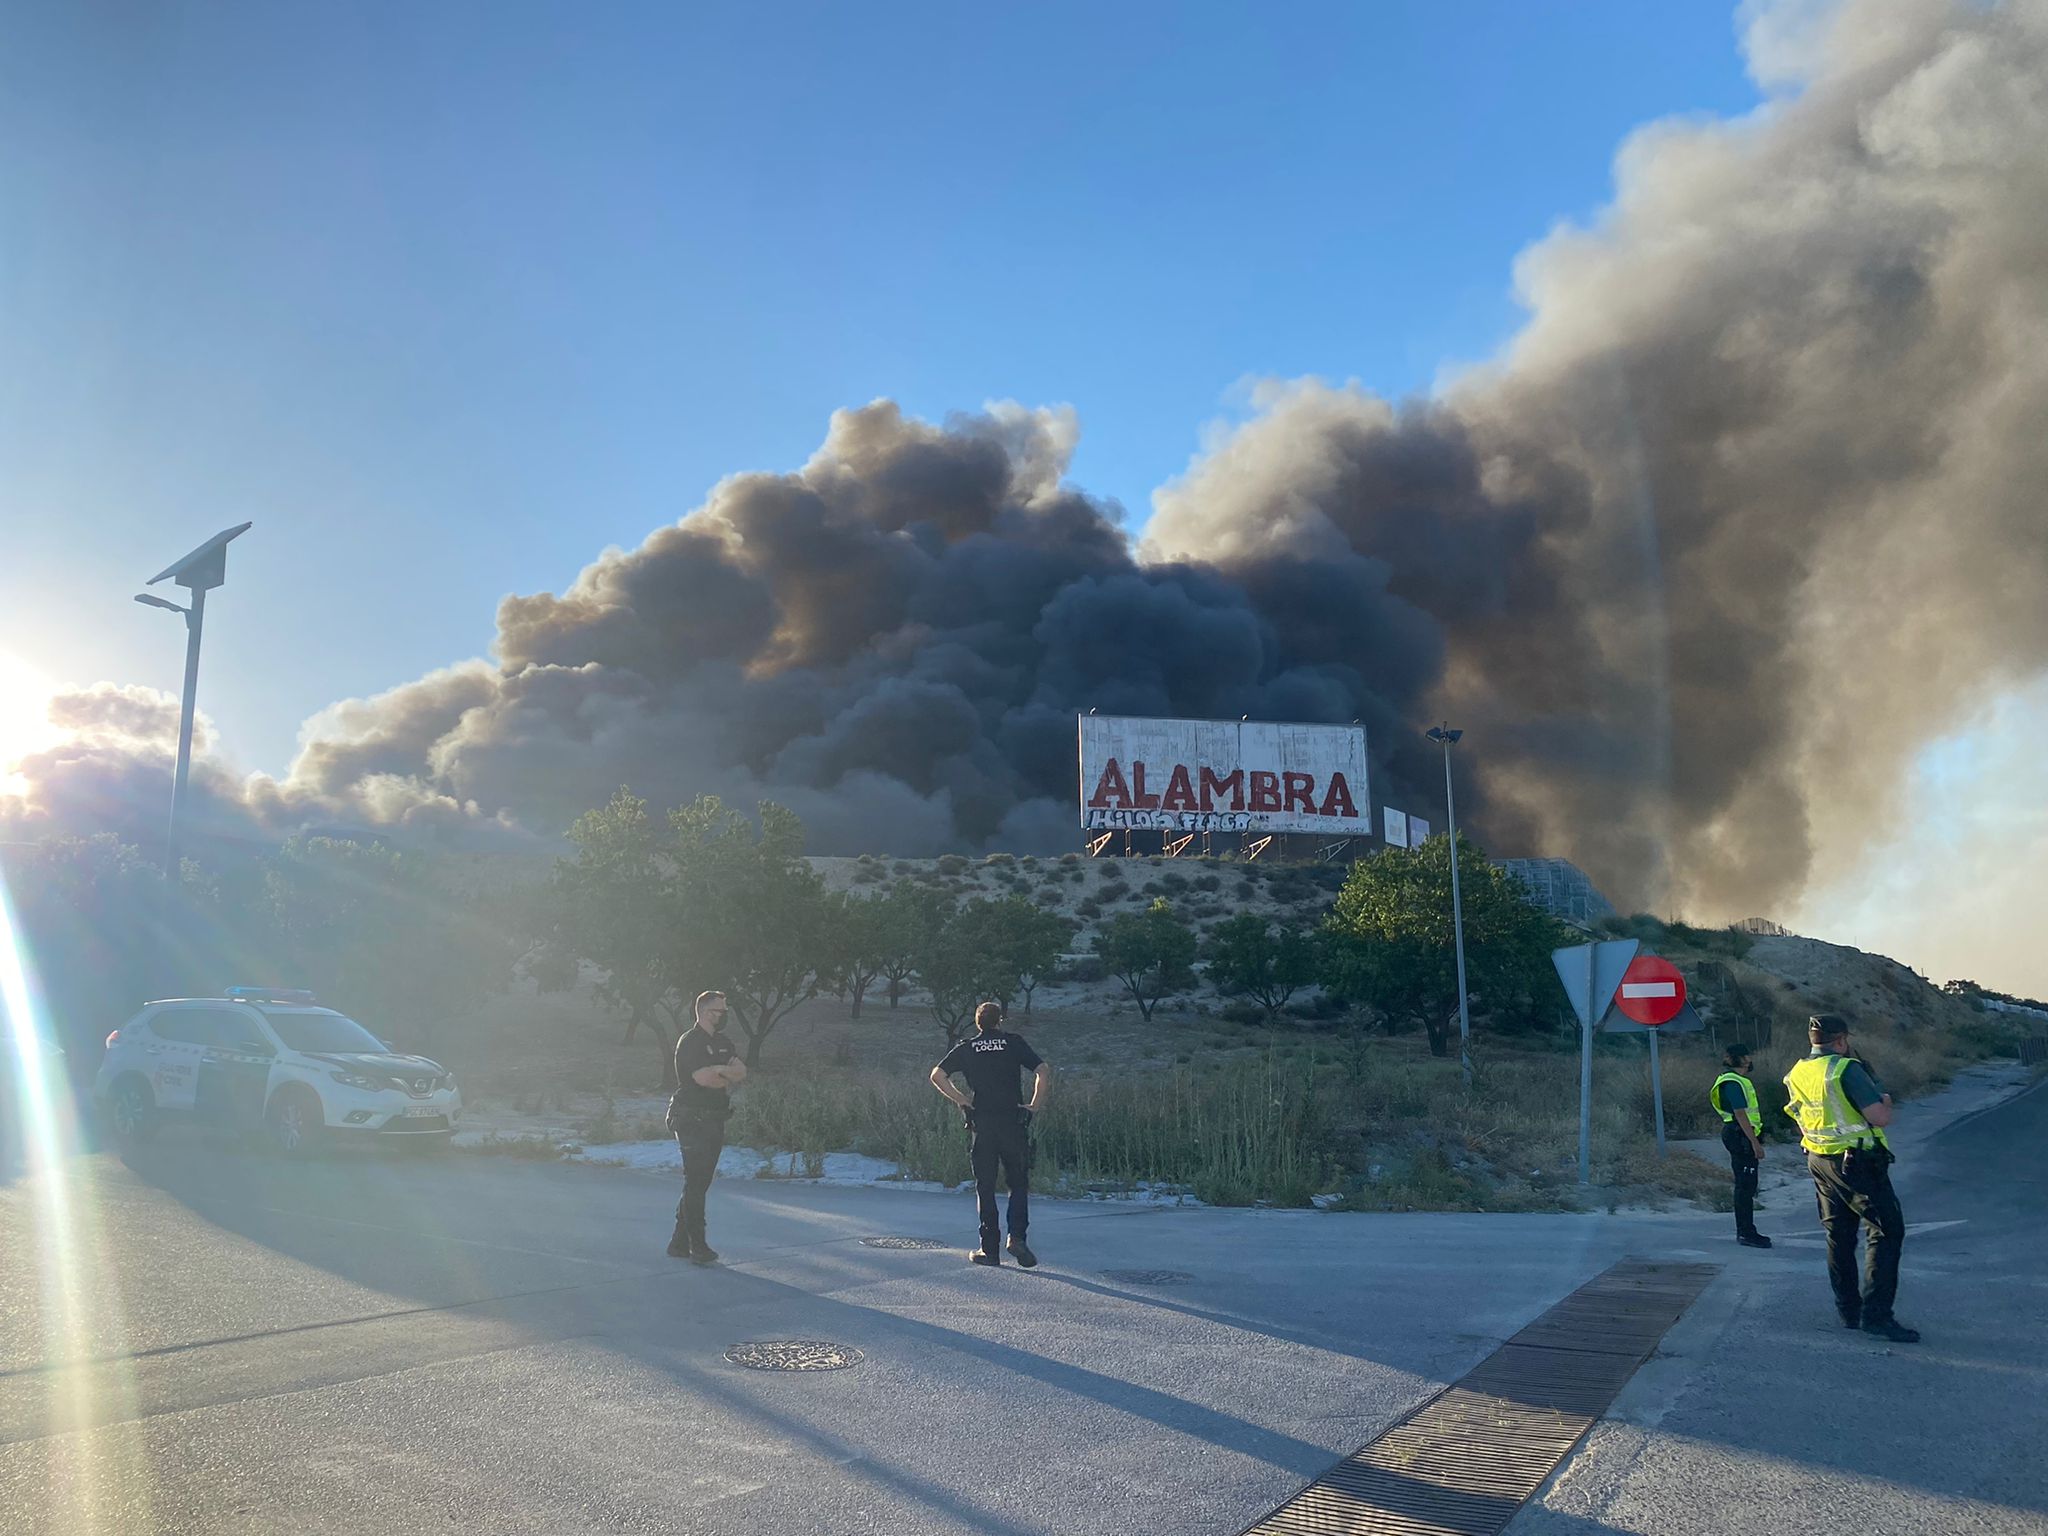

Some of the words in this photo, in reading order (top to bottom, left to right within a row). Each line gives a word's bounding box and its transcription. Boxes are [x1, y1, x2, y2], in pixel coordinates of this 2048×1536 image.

[1088, 757, 1358, 817] ALAMBRA
[972, 1039, 1007, 1048] POLICIA
[976, 1044, 1004, 1052] LOCAL
